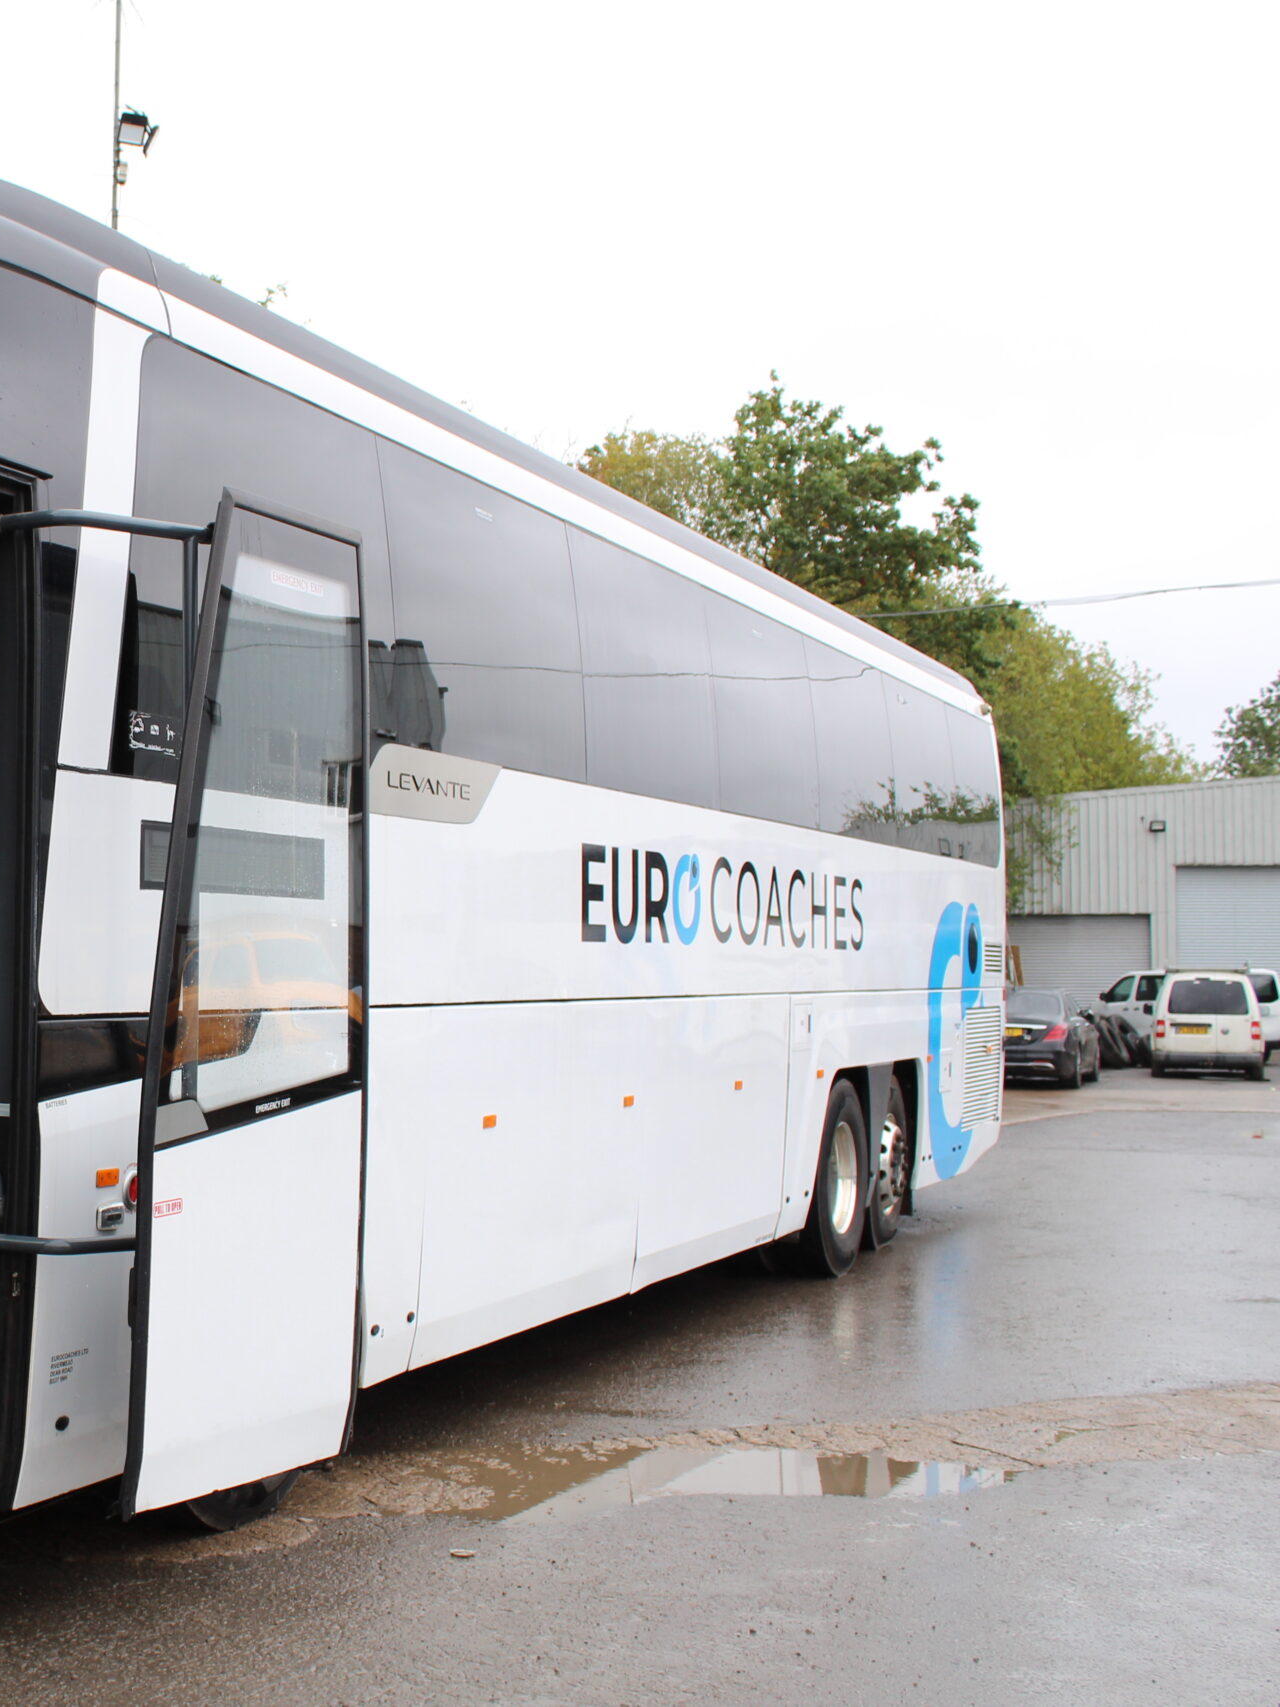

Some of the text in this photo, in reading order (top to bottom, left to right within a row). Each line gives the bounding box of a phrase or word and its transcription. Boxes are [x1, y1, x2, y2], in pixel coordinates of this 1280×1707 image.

[387, 770, 470, 800] LEVANTE
[255, 1098, 291, 1114] EMERGENCY EXIT
